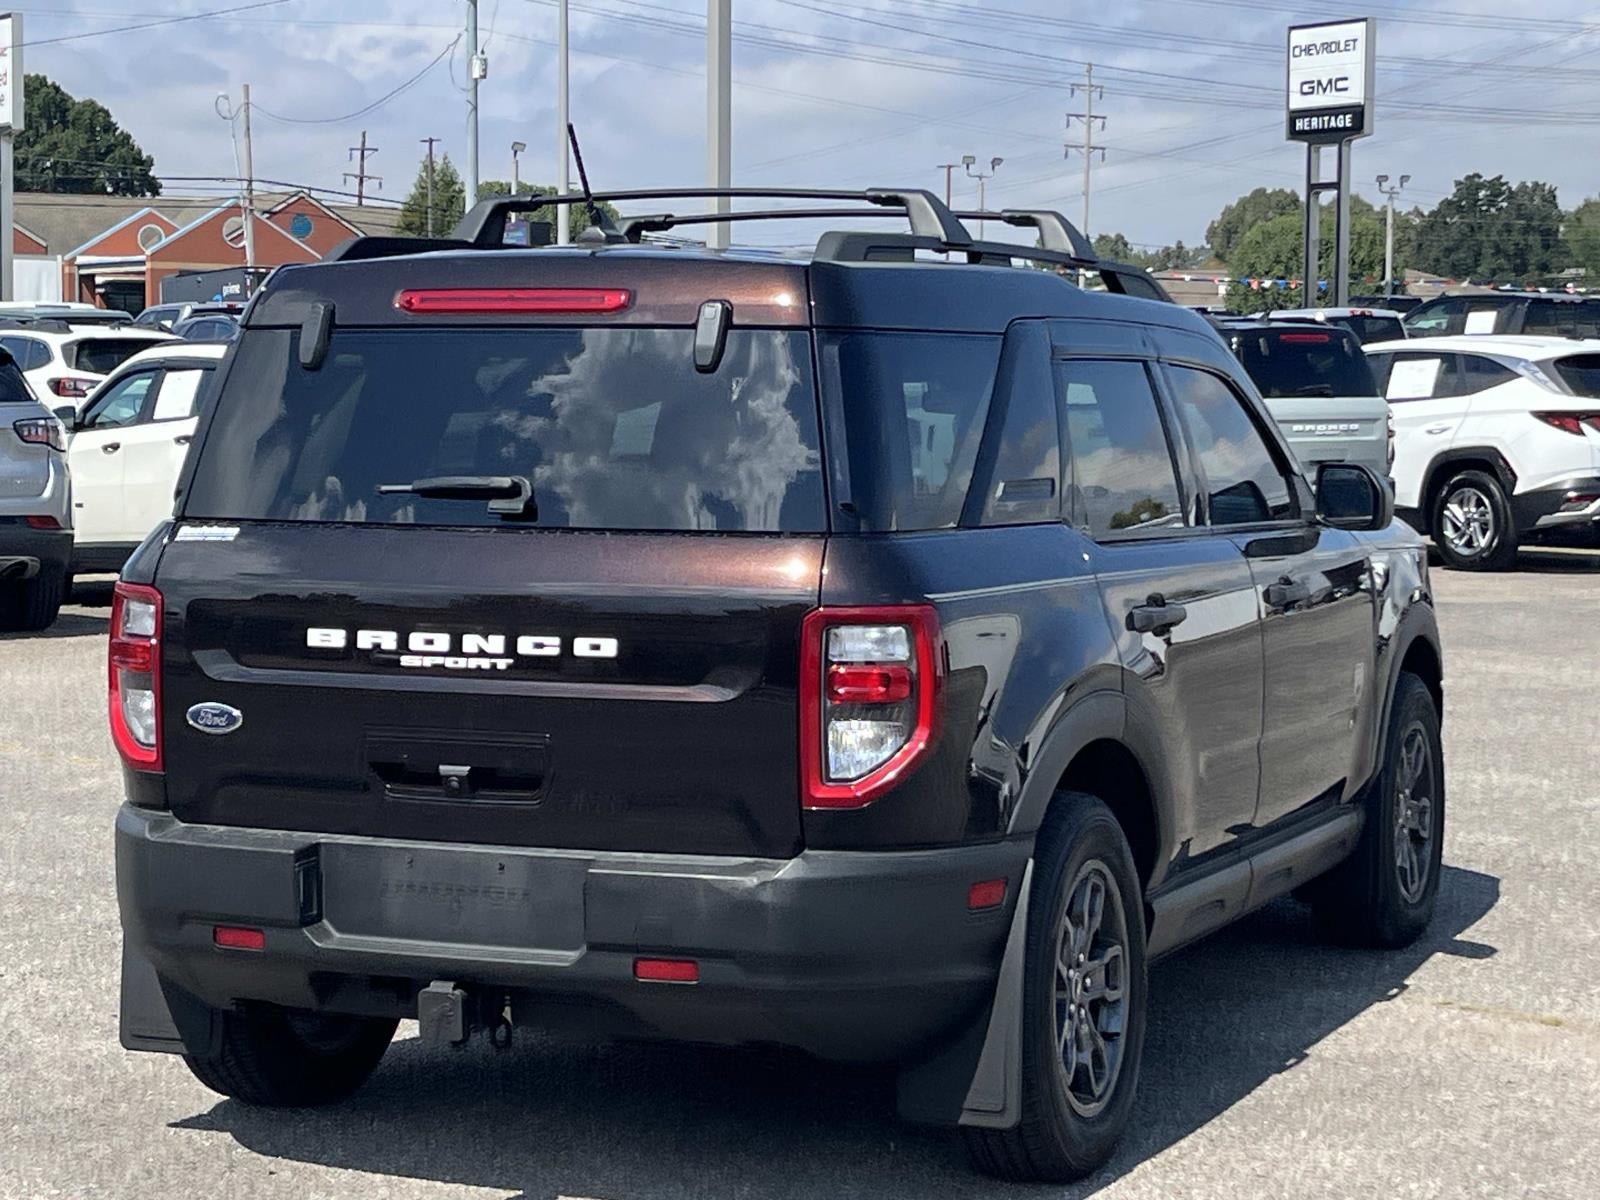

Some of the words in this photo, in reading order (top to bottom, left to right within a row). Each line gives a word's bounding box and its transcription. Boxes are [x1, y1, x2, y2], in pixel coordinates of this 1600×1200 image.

[1292, 38, 1358, 58] CHEVROLET
[1300, 76, 1349, 96] GMC
[1295, 113, 1353, 131] HERITAGE
[306, 627, 618, 657] BRONCO
[399, 654, 514, 670] SPORT
